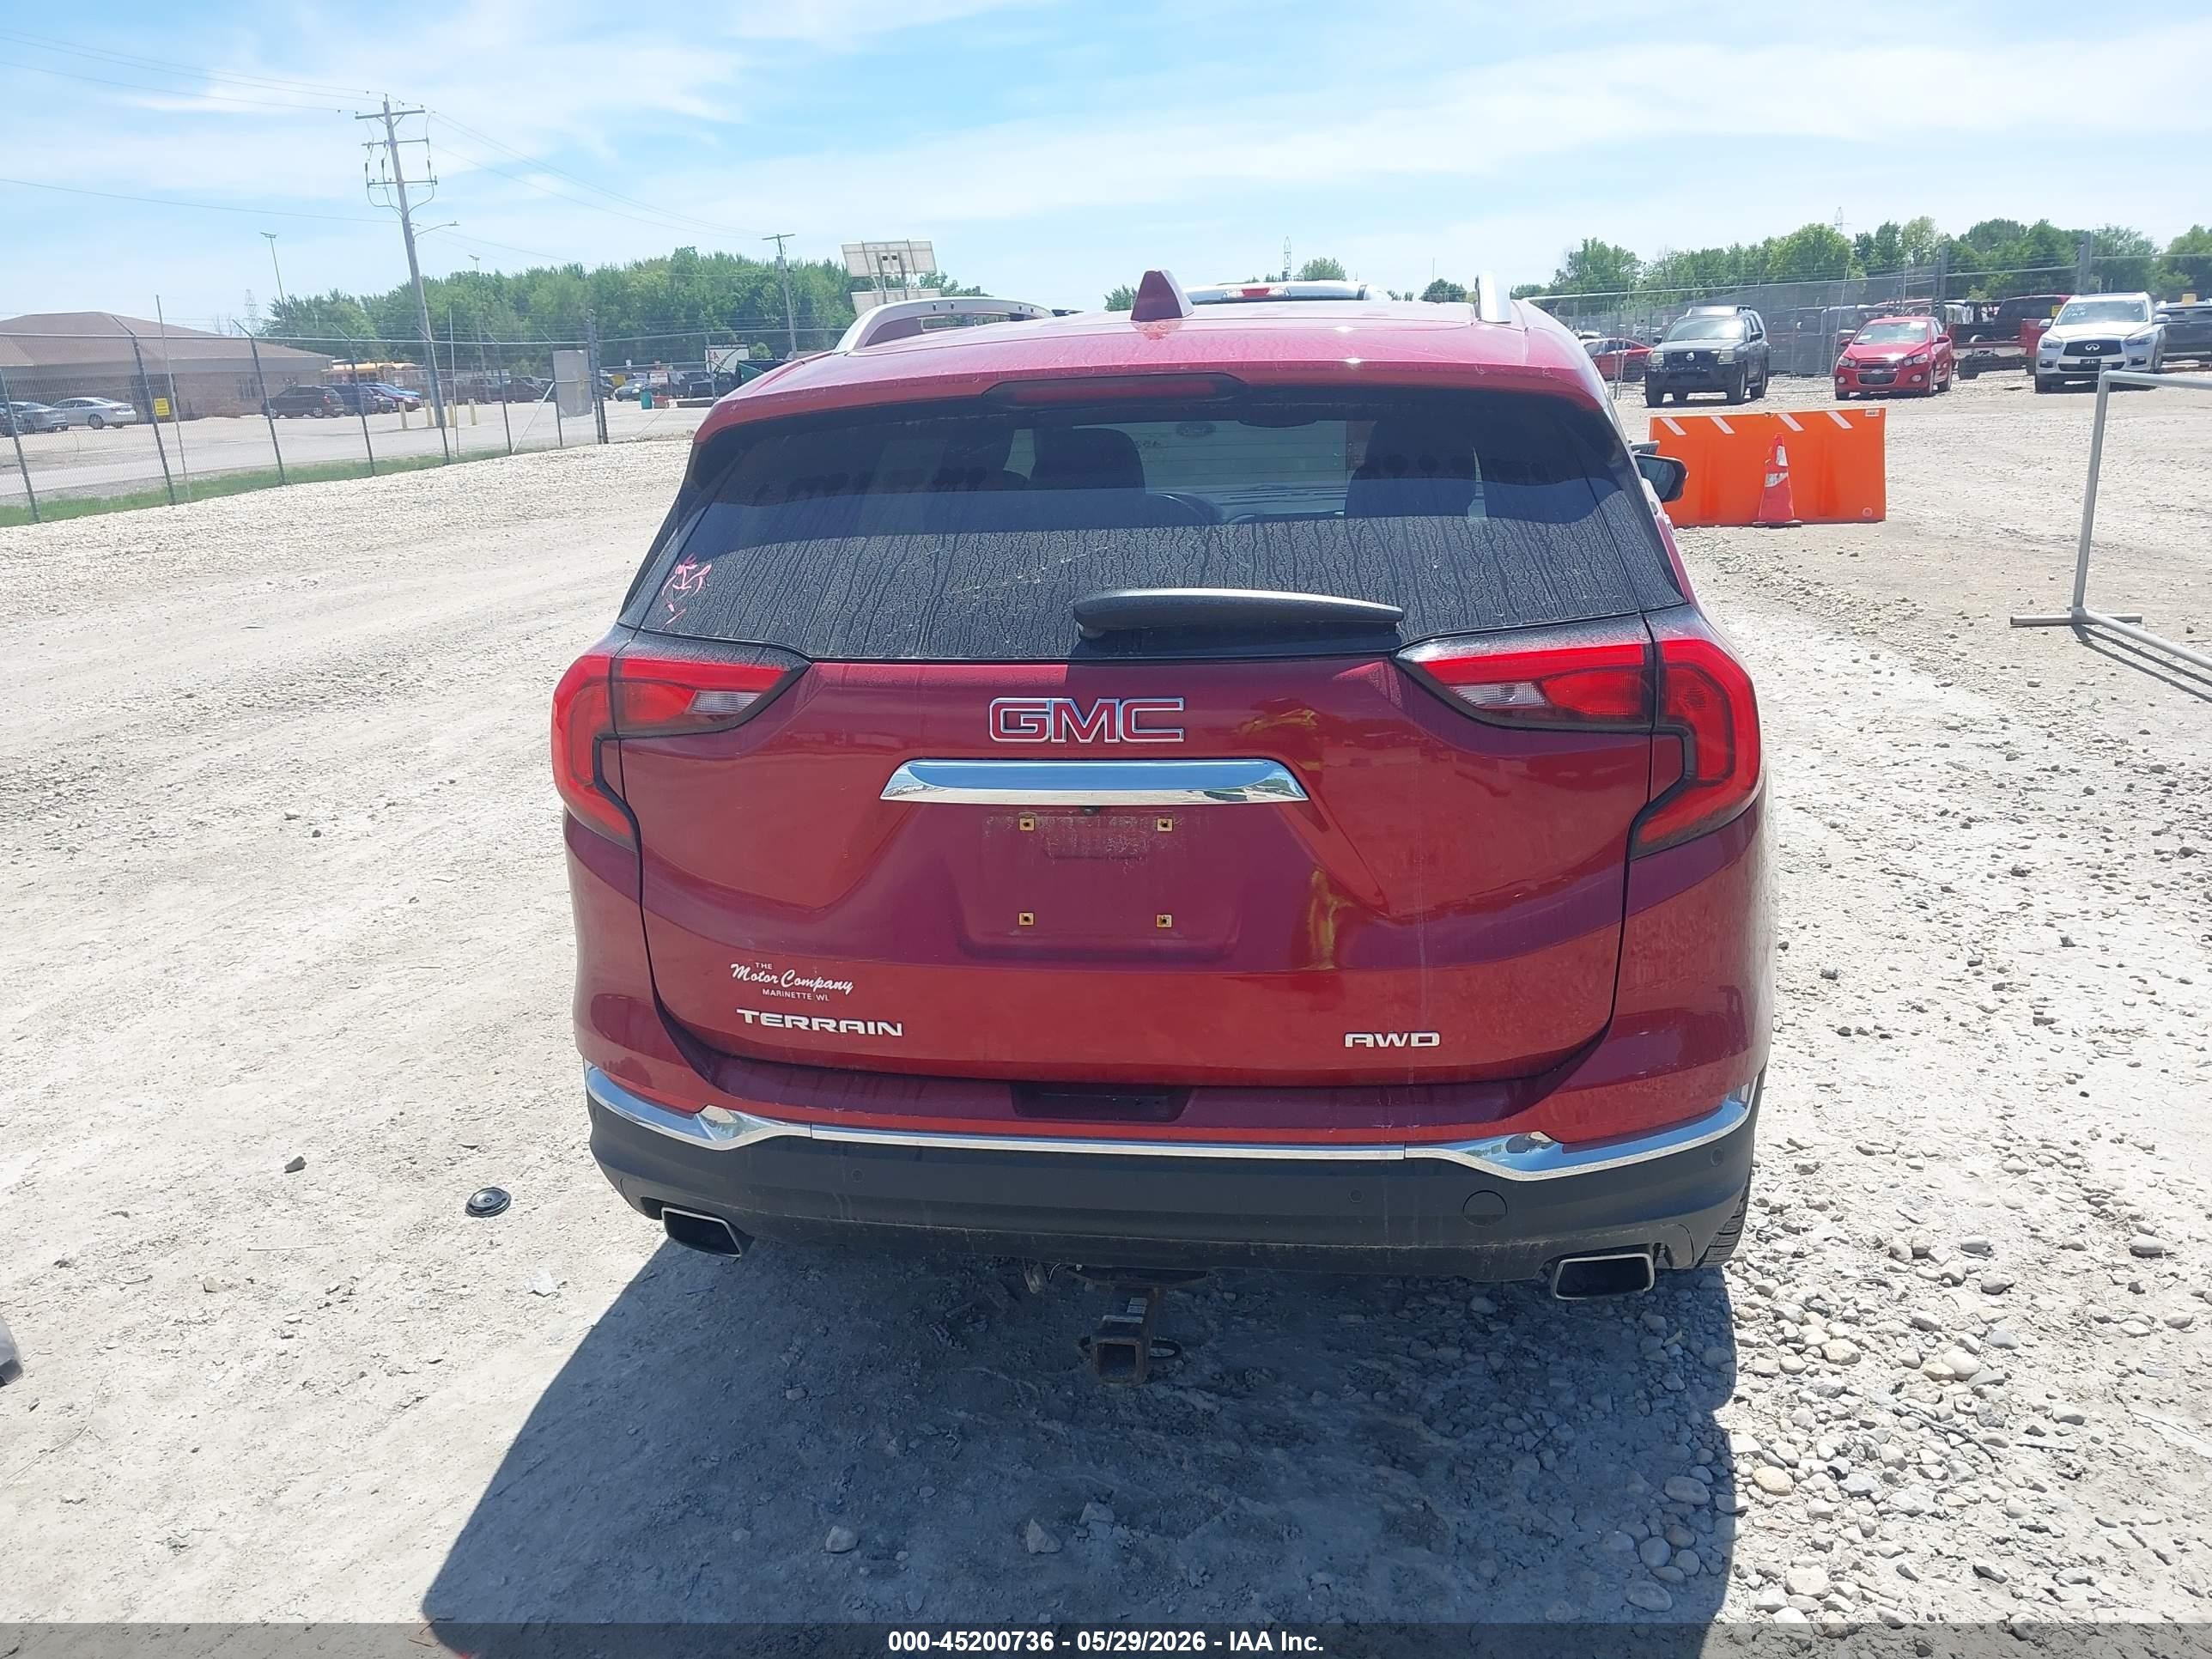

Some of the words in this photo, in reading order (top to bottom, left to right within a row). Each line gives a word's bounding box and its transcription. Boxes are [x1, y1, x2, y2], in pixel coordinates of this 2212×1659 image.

[989, 696, 1184, 744] GMC
[730, 963, 780, 982] Motor
[780, 969, 854, 996] Company
[762, 988, 812, 1000] MARINETTE
[736, 1007, 903, 1037] TERRAIN
[1344, 1031, 1441, 1048] AWD
